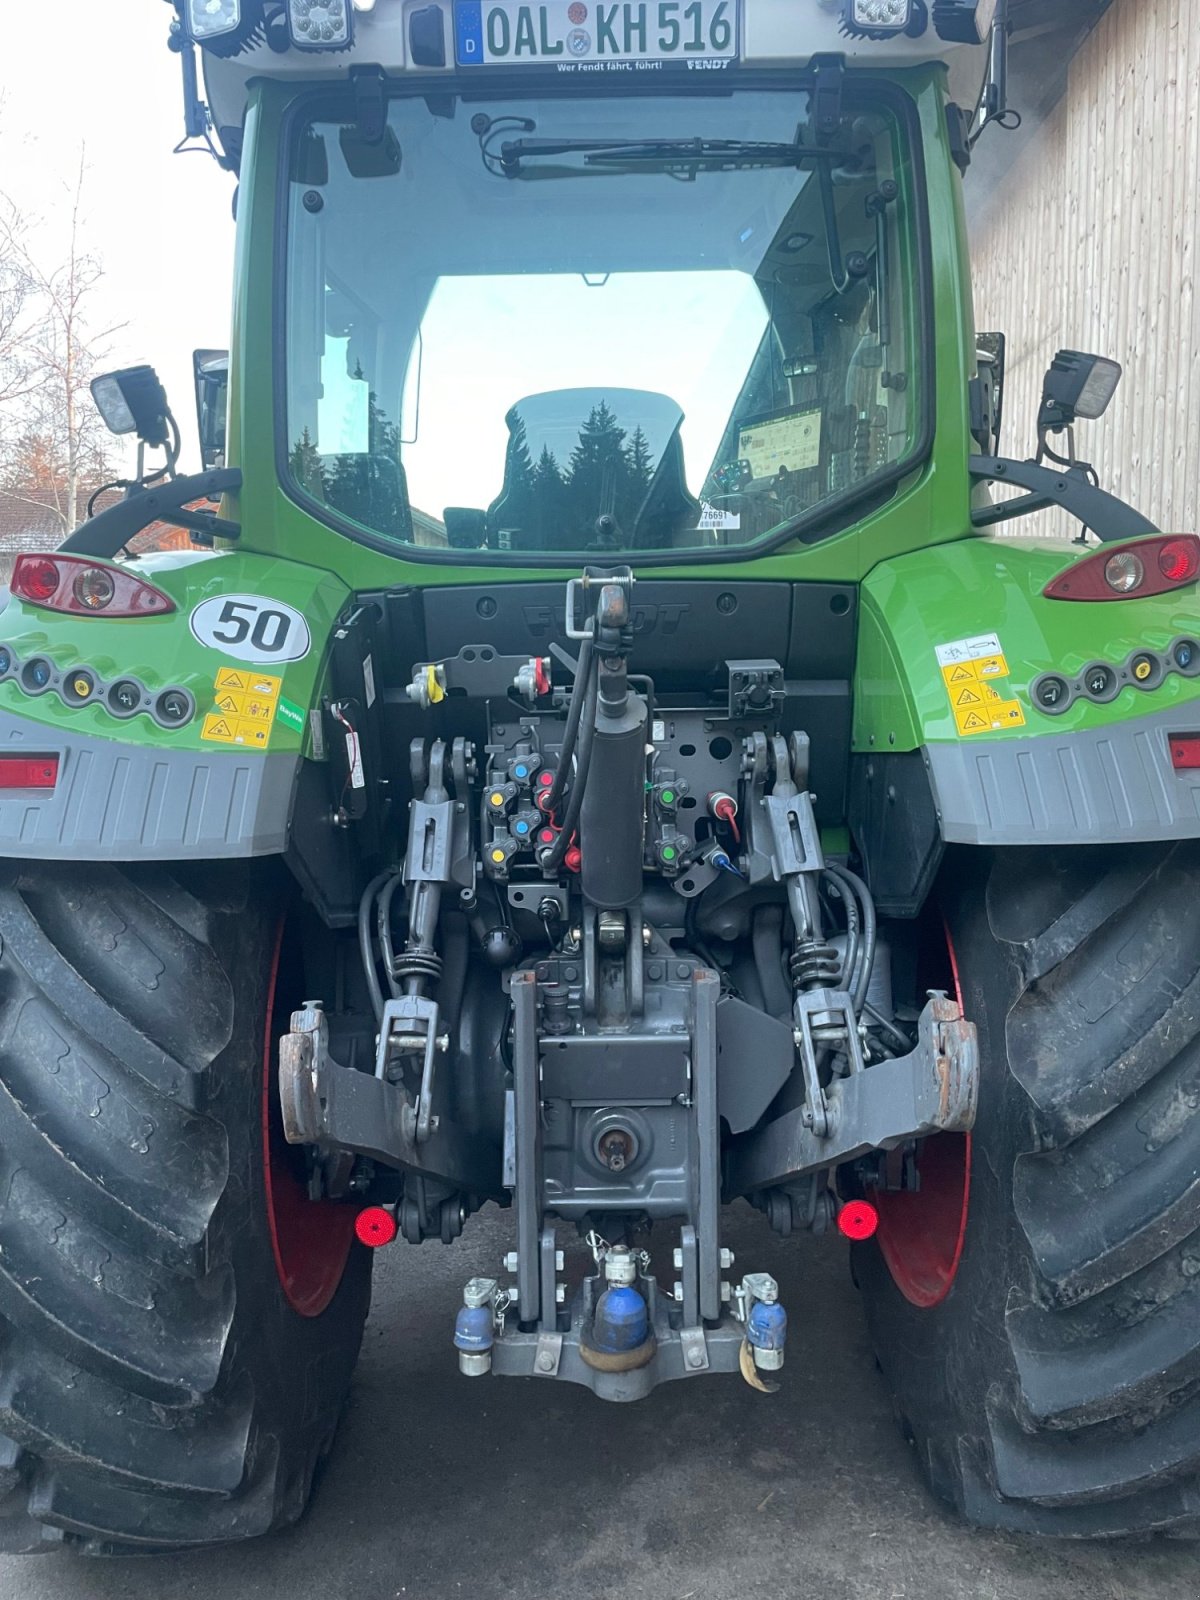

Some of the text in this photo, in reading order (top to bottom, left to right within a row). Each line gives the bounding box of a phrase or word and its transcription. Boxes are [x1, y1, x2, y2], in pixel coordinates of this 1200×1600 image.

[487, 1, 731, 56] OAL KH 516
[466, 39, 475, 53] D
[557, 61, 662, 72] Wer Fendt fährt, führt!
[687, 59, 730, 70] FENDT
[212, 600, 291, 652] 50
